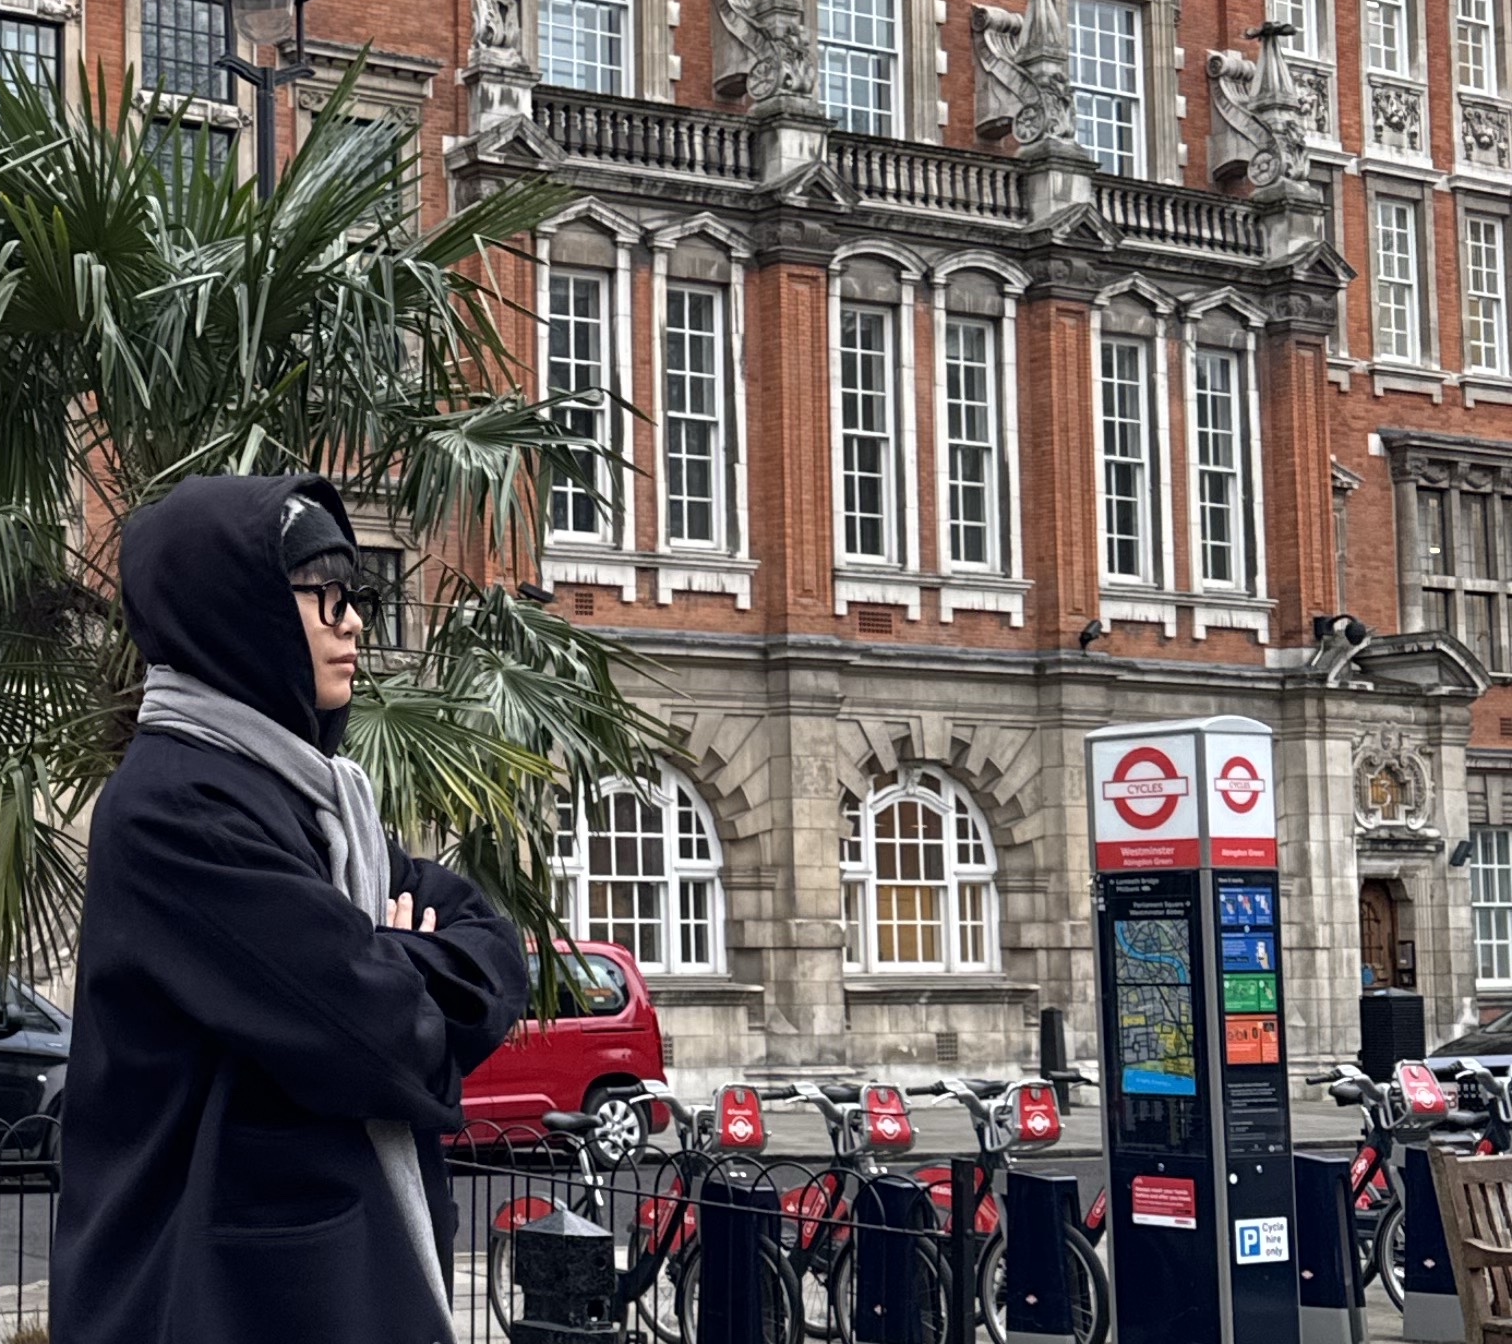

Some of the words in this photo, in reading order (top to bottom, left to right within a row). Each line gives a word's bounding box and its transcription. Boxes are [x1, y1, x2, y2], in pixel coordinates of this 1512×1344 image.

[1127, 783, 1163, 795] CYCLES
[1229, 781, 1250, 789] CYCLES
[1120, 845, 1175, 856] Westminster
[1261, 1222, 1284, 1233] Cycle
[1243, 1229, 1258, 1256] P
[1265, 1233, 1281, 1243] hire
[1265, 1247, 1283, 1257] only
